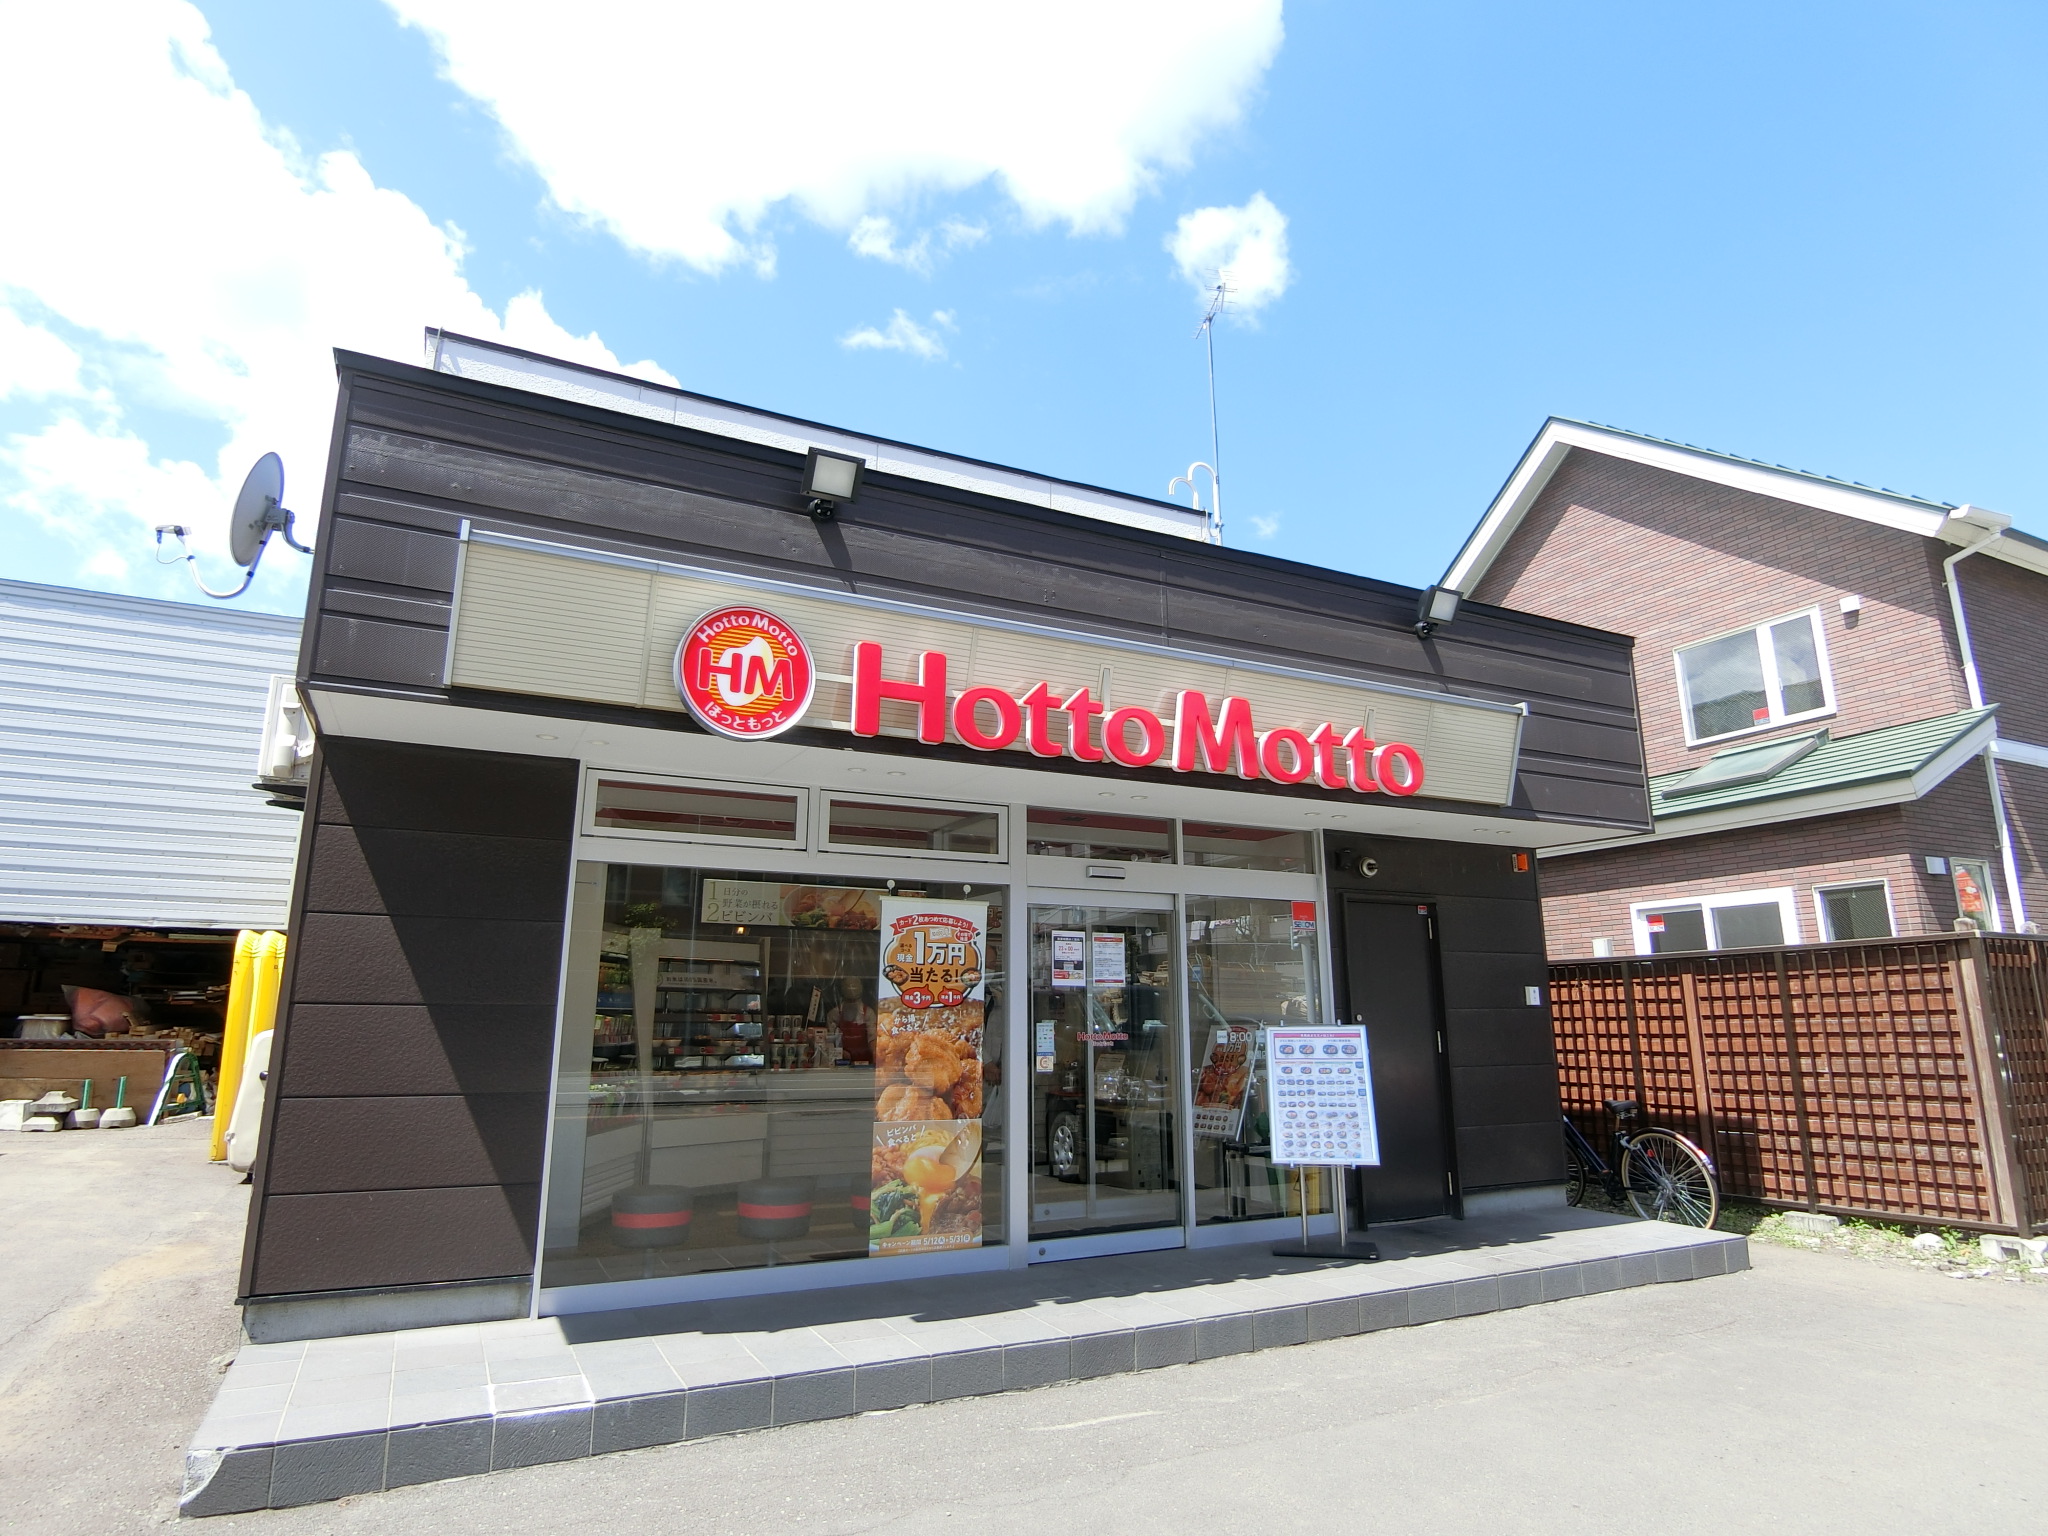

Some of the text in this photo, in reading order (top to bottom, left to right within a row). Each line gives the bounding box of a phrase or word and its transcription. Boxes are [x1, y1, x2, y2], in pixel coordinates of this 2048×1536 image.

[697, 647, 795, 701] HM
[704, 701, 788, 731] ほっともっと
[723, 887, 749, 896] 日分の
[722, 898, 778, 910] 野菜が摂れる
[722, 909, 773, 922] ビビンバ
[1293, 920, 1315, 929] SECOM
[891, 1021, 920, 1035] 食べると
[887, 1123, 917, 1137] ビビンバ
[887, 1133, 917, 1147] 食べると
